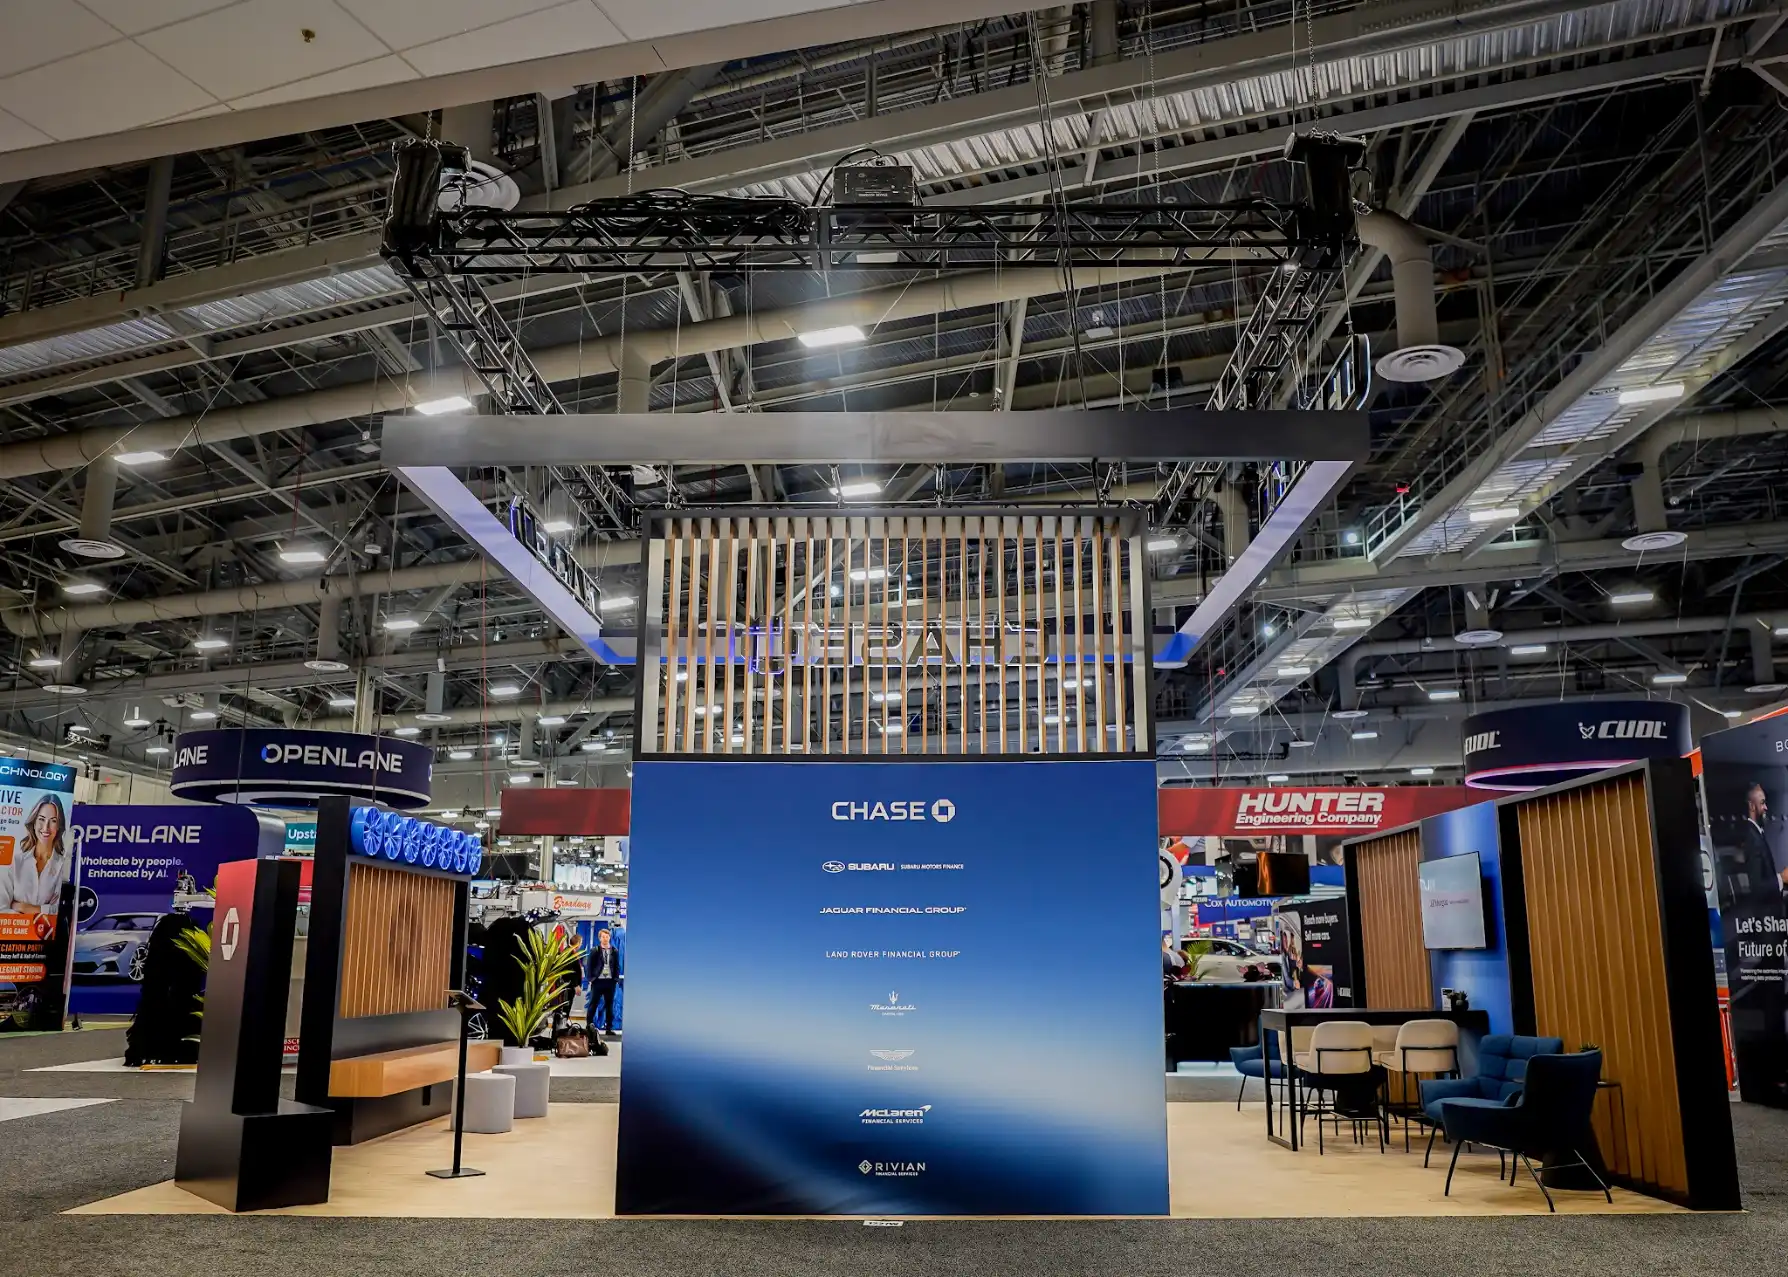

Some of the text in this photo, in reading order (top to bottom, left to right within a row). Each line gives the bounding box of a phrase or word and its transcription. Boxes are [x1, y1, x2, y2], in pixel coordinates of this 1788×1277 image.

[1597, 719, 1668, 739] CUDL
[261, 743, 404, 774] OPENLANE
[0, 789, 22, 805] IVE
[1238, 792, 1385, 813] HUNTER
[832, 801, 927, 821] CHASE
[1235, 812, 1315, 826] Engineering
[70, 825, 202, 844] OPENLANE
[131, 856, 144, 868] by
[146, 856, 184, 868] people.
[847, 863, 895, 871] SUBARU
[88, 868, 139, 878] Enhanced
[141, 868, 155, 880] by
[1735, 917, 1762, 934] Let's
[0, 943, 26, 953] CIATION
[1738, 940, 1773, 957] Future
[859, 1109, 924, 1117] McLaren
[875, 1162, 926, 1171] RIVIAN
